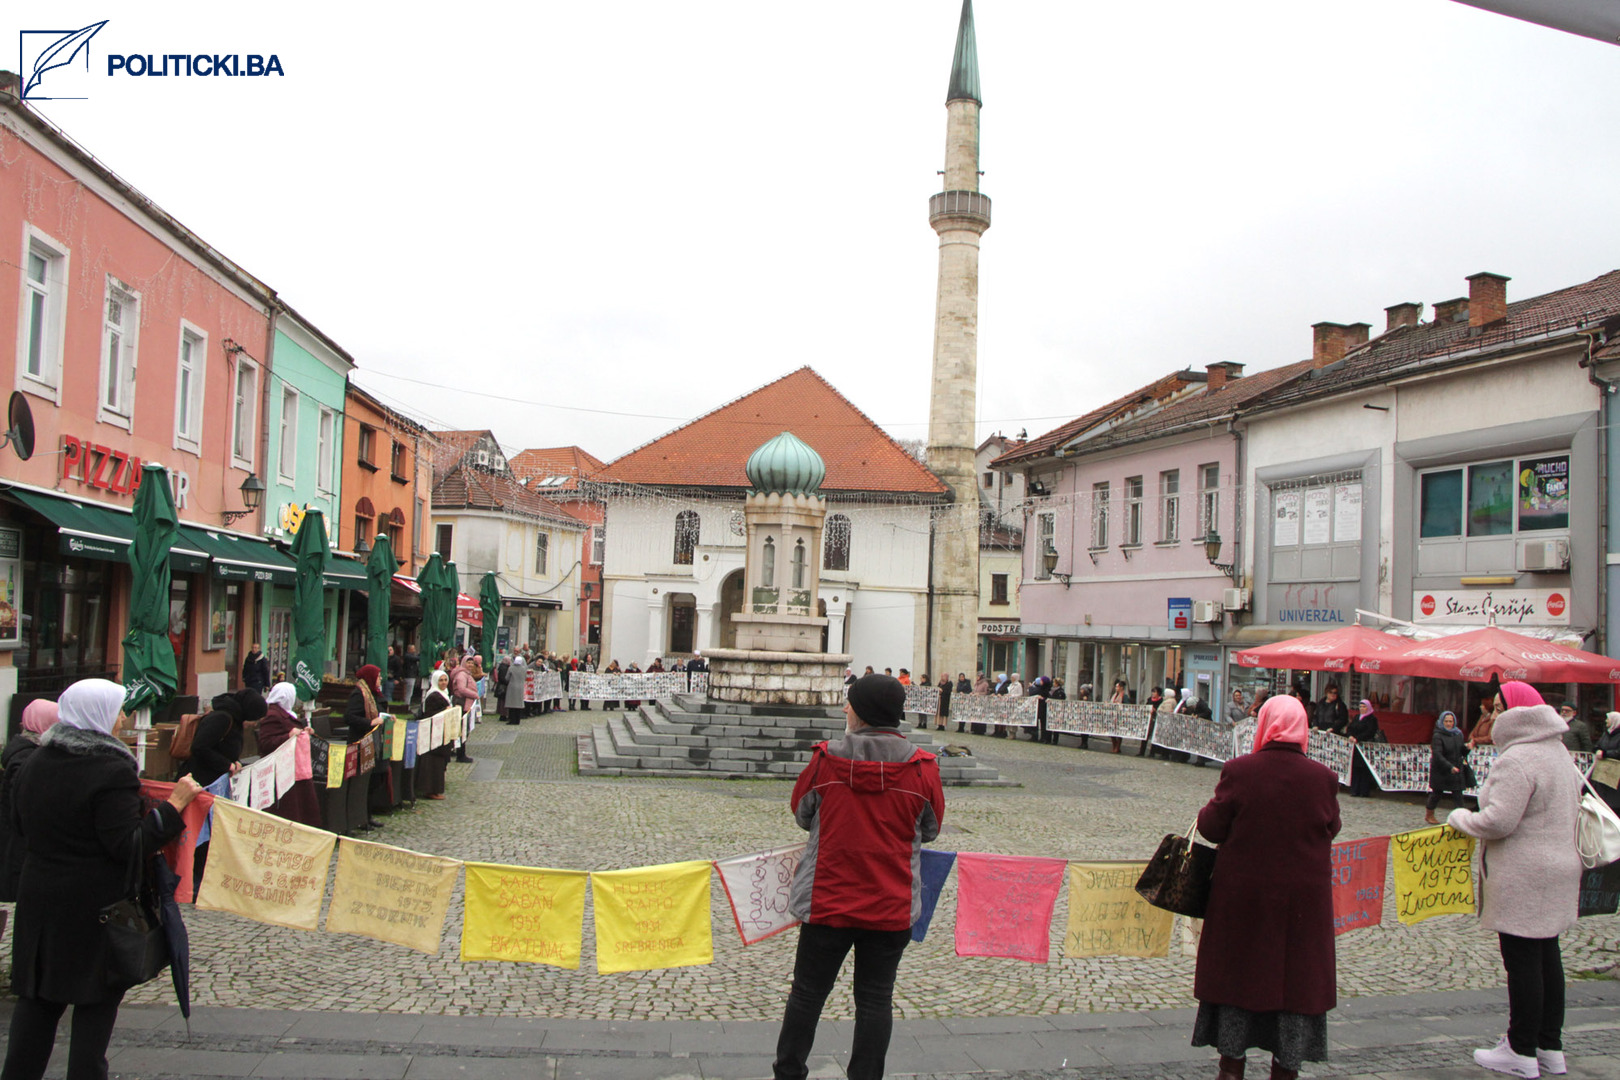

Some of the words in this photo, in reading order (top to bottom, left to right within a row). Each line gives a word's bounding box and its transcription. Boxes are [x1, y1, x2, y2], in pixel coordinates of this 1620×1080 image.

[63, 434, 141, 495] PIZZA
[981, 624, 1021, 633] PODSTRE
[1279, 609, 1345, 622] UNIVERZAL
[221, 874, 298, 906] ZVORNIK
[1419, 865, 1470, 890] 1975
[350, 901, 430, 928] ZVORNIK
[490, 935, 566, 961] BRATUNAC
